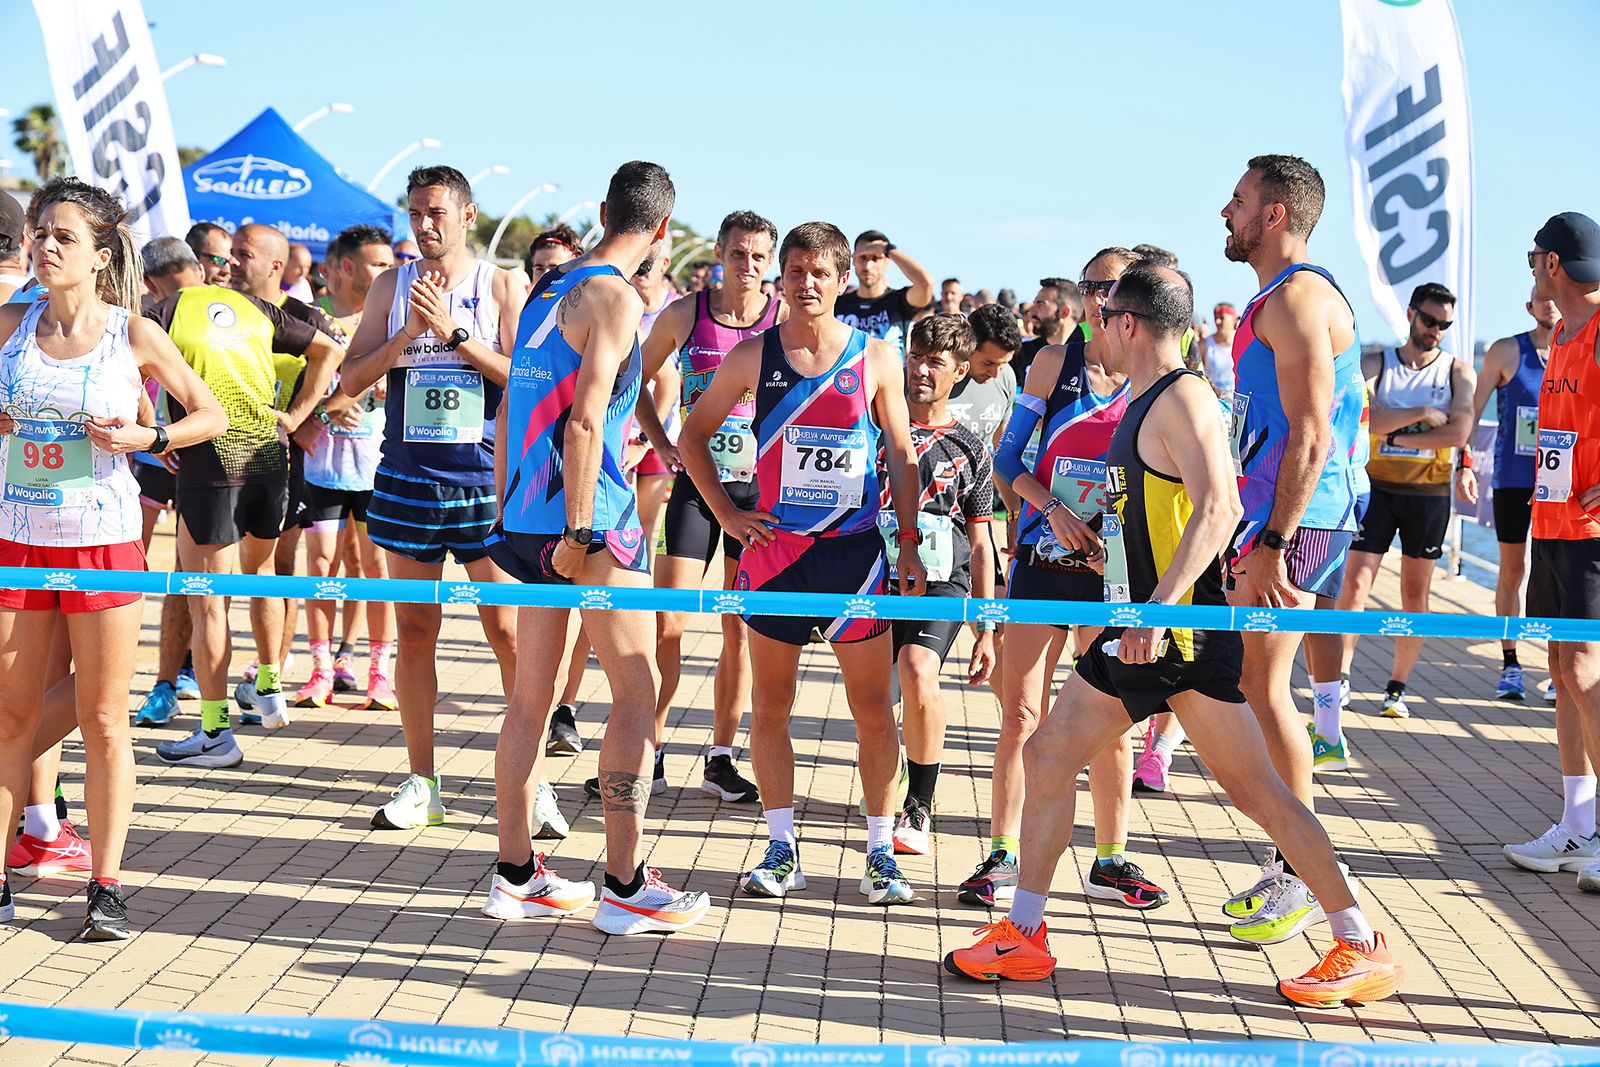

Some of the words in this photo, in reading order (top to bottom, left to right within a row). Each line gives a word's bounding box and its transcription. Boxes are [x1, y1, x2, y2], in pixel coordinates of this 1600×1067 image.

[424, 342, 450, 354] bala
[531, 366, 552, 380] Páez
[424, 388, 460, 411] 88
[415, 426, 453, 437] Wayalia
[23, 441, 65, 470] 98
[796, 446, 852, 473] 784
[1118, 466, 1127, 492] TEAM
[14, 486, 57, 501] Wayalia
[793, 488, 833, 500] Wayalia
